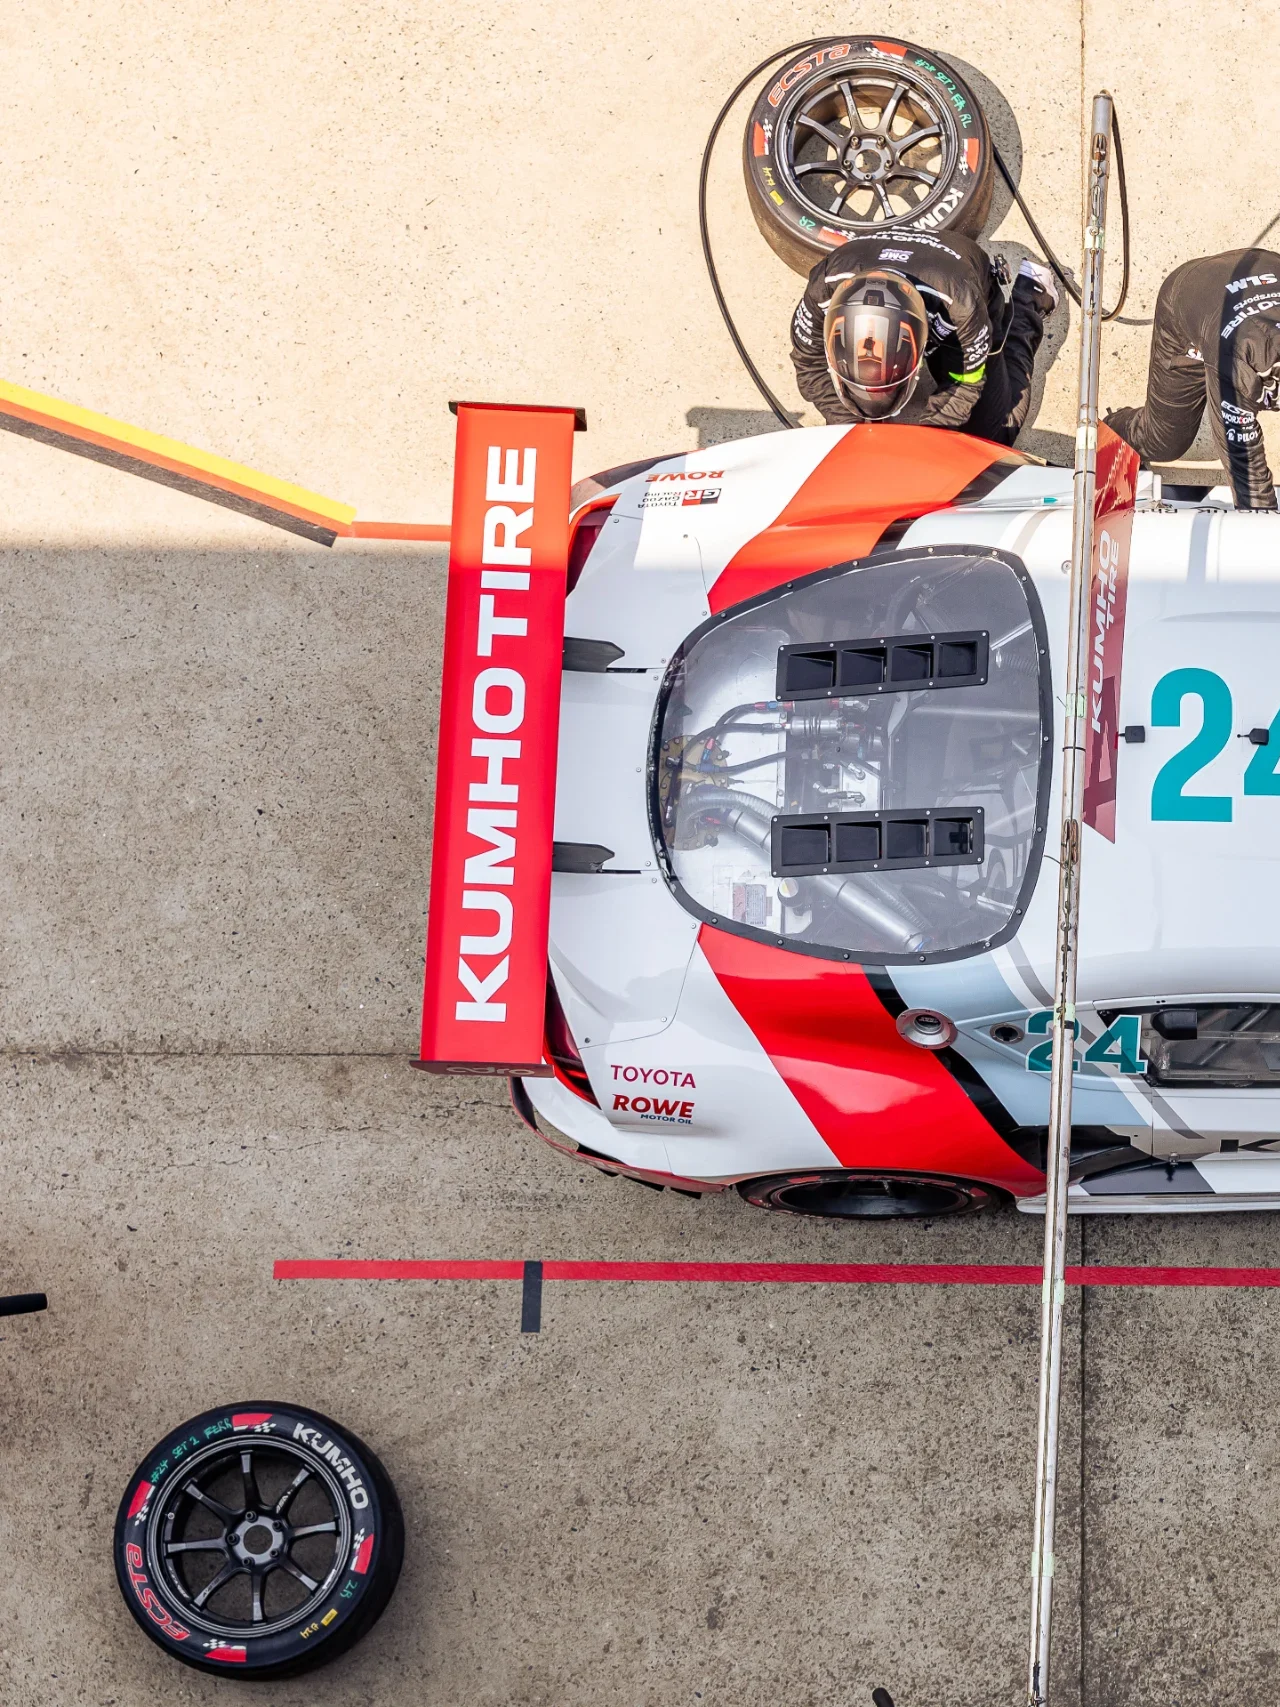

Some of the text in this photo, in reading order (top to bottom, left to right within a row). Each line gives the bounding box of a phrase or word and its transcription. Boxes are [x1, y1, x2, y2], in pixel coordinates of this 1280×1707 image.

[909, 187, 964, 230] KUM
[1225, 273, 1278, 294] SLM
[645, 470, 725, 483] ROWE
[683, 488, 721, 503] GR
[1104, 540, 1119, 630] TIRE
[1091, 530, 1110, 734] KUMHO
[1026, 1010, 1148, 1074] 24
[610, 1065, 696, 1088] TOYOTA
[612, 1094, 695, 1118] ROWE
[640, 1114, 676, 1123] MOTOR
[151, 1459, 170, 1483] #24
[171, 1442, 191, 1460] SET
[292, 1423, 369, 1510] KUMHO
